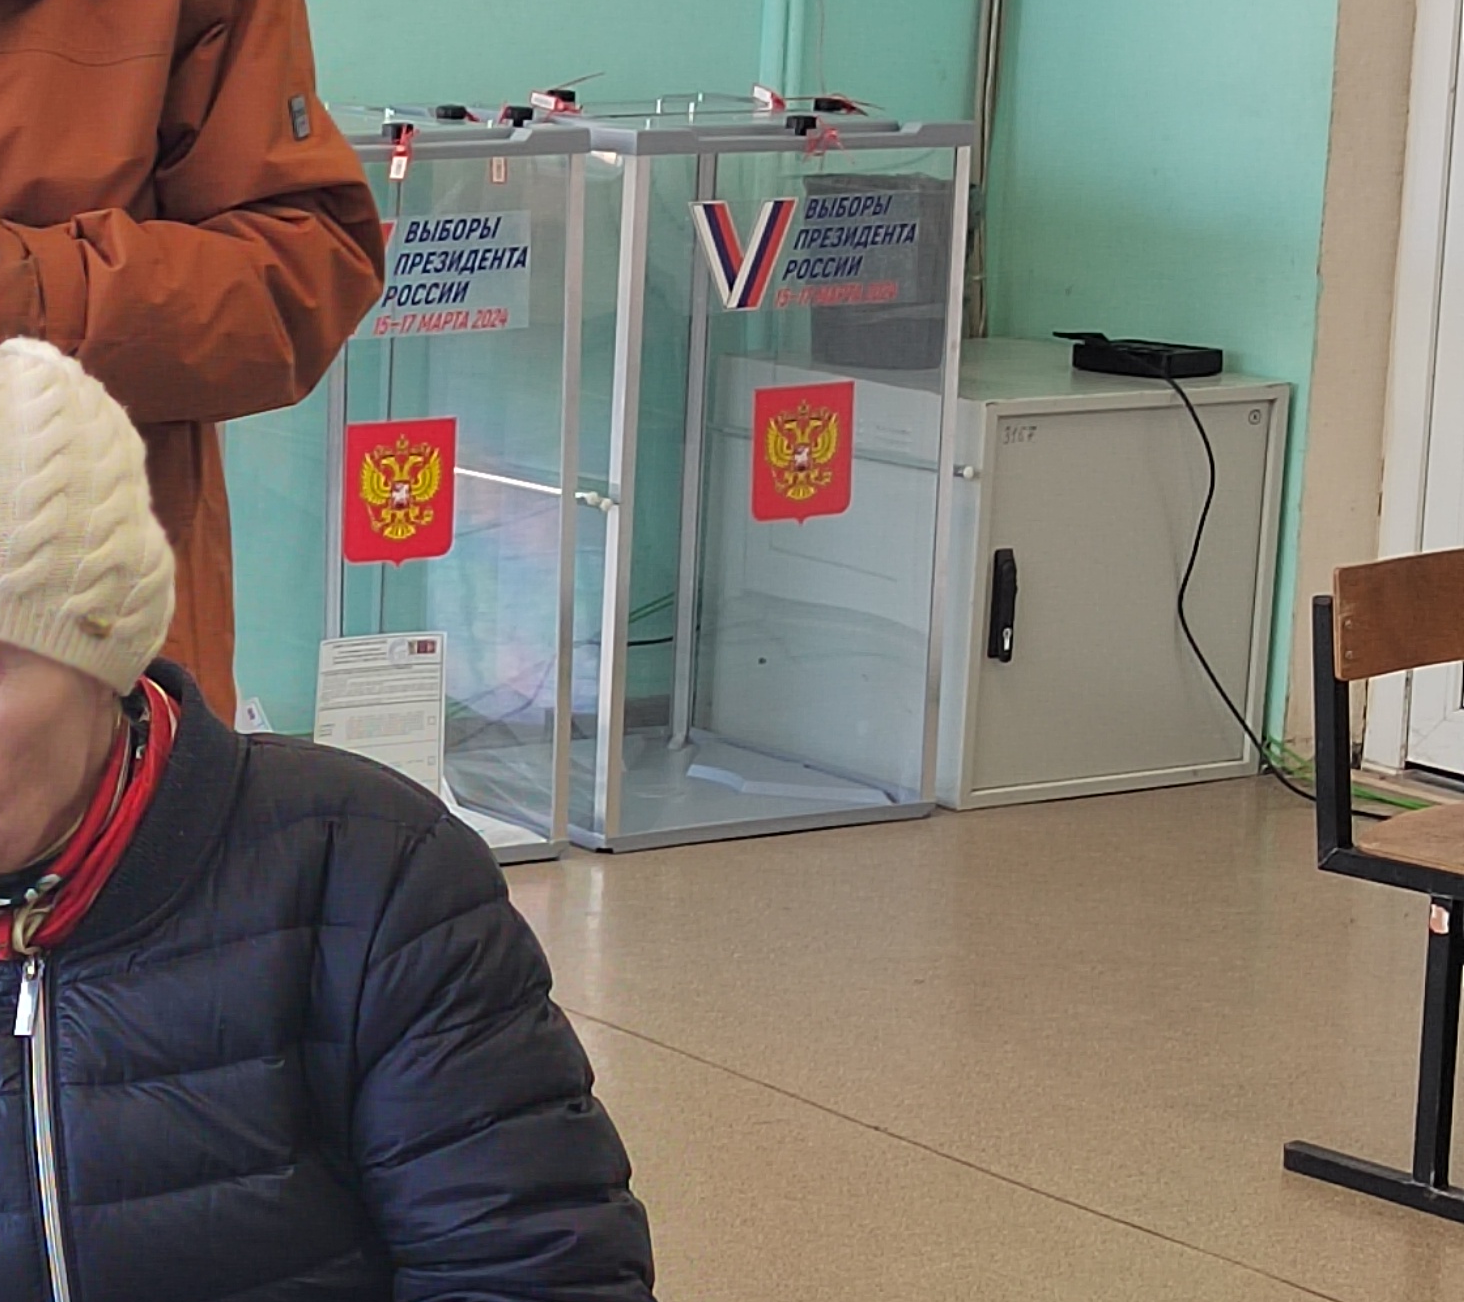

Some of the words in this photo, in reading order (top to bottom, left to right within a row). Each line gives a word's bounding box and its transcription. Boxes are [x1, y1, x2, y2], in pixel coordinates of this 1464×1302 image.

[805, 196, 893, 219] ВЫБОРЫ
[404, 216, 502, 243] ВЫБОРЫ
[794, 223, 918, 250] ПРЕЗИДЕНТА
[393, 246, 529, 276] ПРЕЗИДЕНТА
[782, 256, 863, 281] РОССИИ
[381, 280, 471, 308] РОССИИ
[417, 310, 469, 332] МАРТА
[471, 308, 509, 329] 2024
